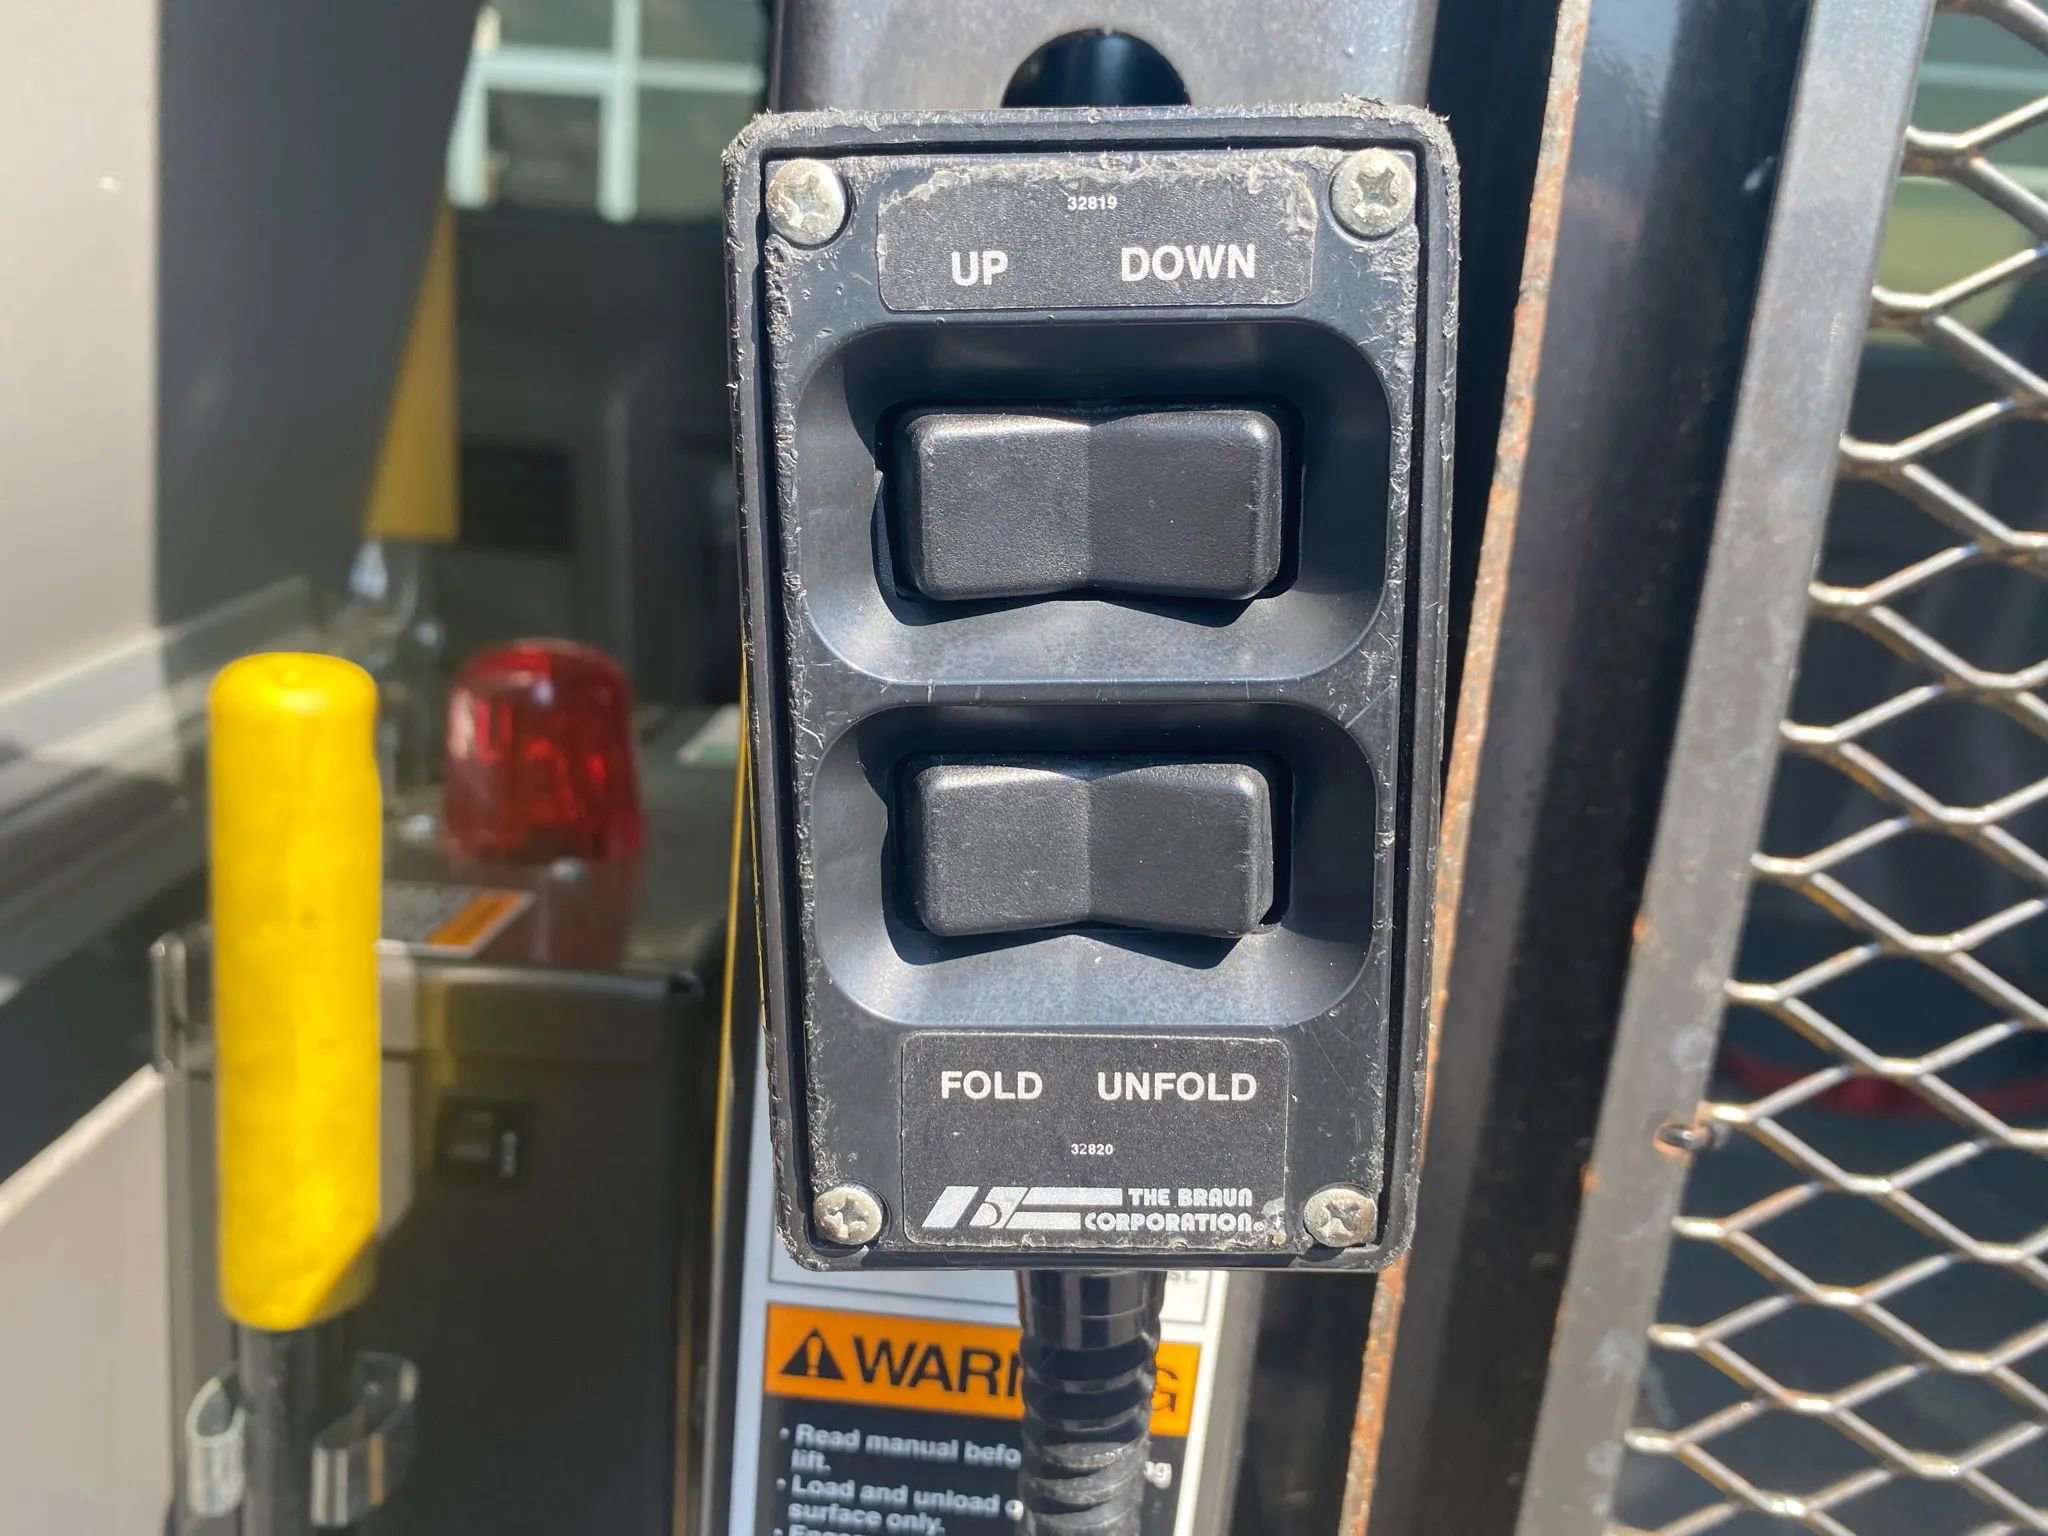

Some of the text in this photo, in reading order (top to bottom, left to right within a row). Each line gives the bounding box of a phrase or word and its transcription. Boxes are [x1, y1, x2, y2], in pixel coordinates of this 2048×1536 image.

[1067, 195, 1118, 211] 32819
[951, 244, 1257, 287] UP DOWN
[940, 1070, 1258, 1102] FOLD UNFOLD
[1070, 1143, 1114, 1156] 32820
[1127, 1187, 1253, 1207] THE BRAUN
[1084, 1212, 1252, 1232] CORPORATION
[795, 1423, 1022, 1469] Read manual befo
[791, 1448, 832, 1475] lift.
[791, 1474, 1024, 1520] Load and unload o
[788, 1502, 882, 1530] surface
[885, 1511, 946, 1536] only.
